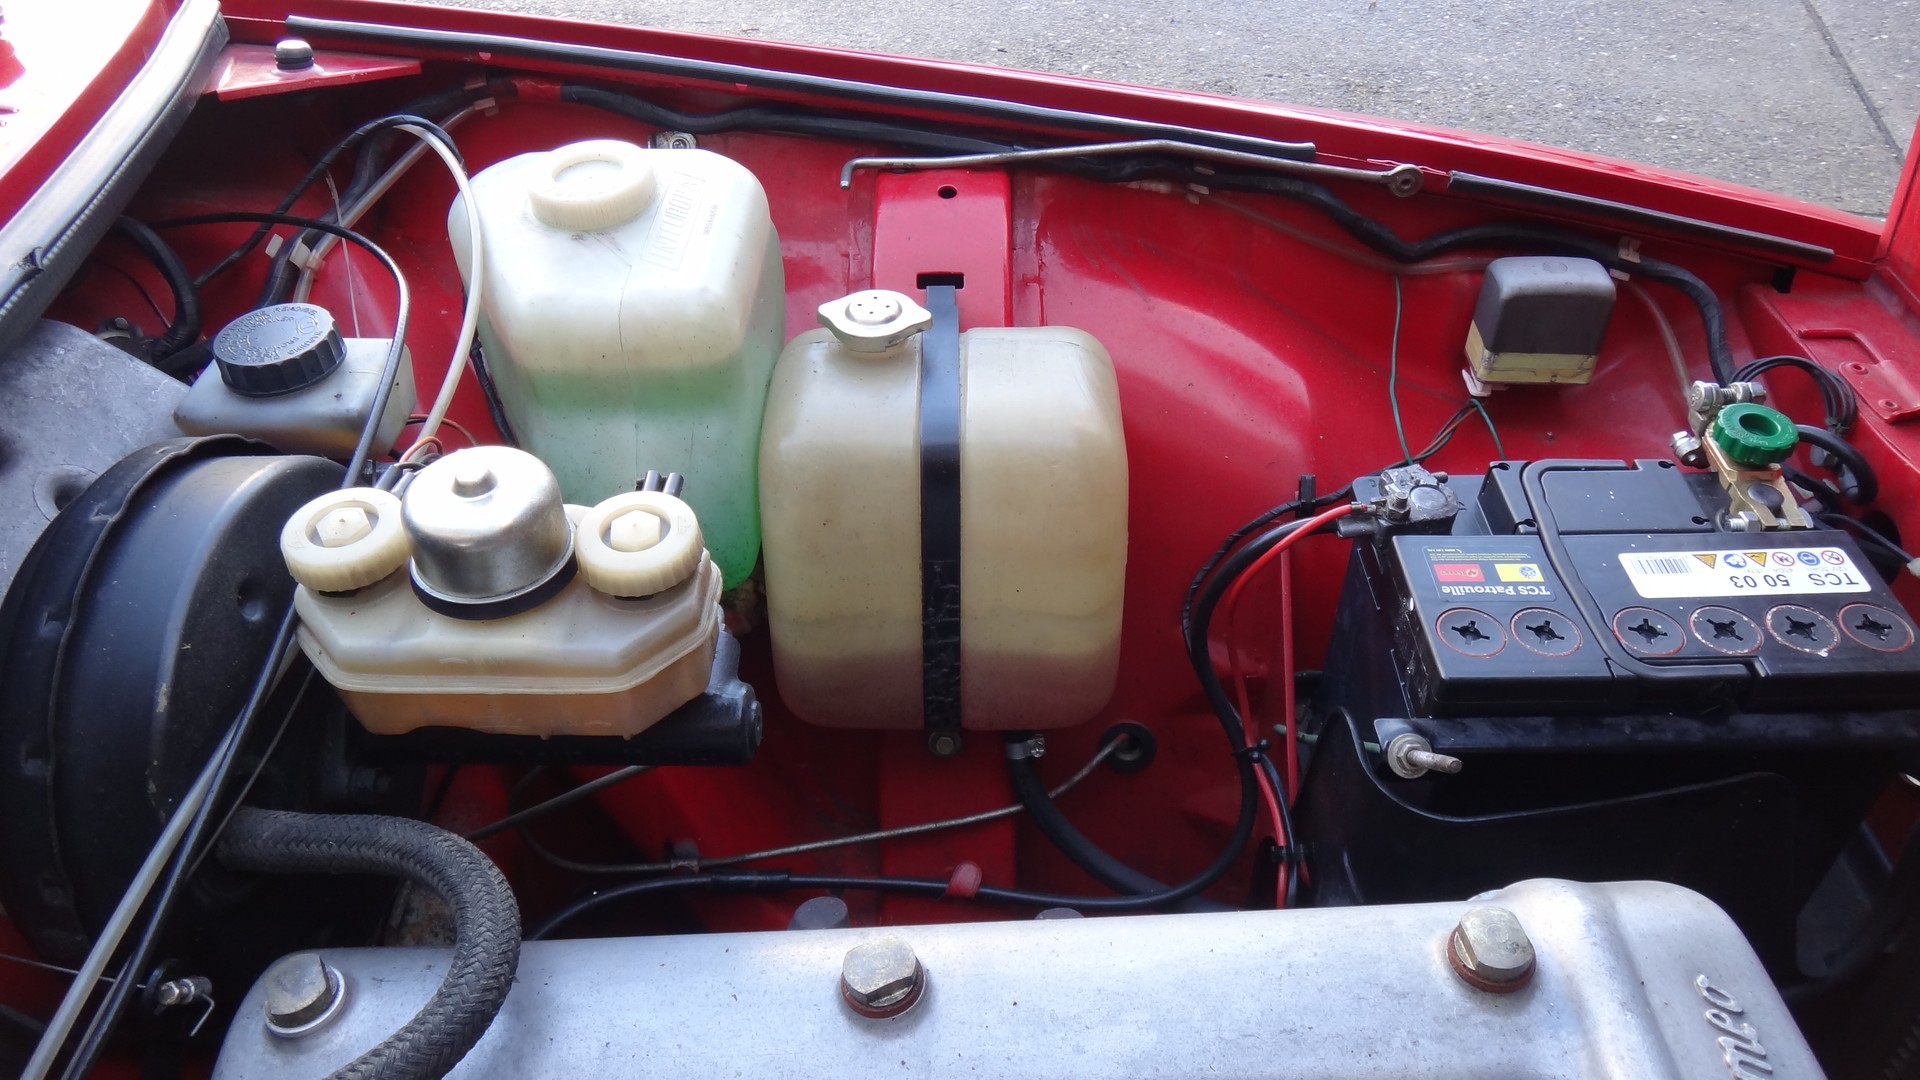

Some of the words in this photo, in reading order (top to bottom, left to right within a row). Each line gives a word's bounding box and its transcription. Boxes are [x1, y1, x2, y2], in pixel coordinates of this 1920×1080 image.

[1730, 575, 1757, 589] 03
[1763, 573, 1791, 588] 50
[1808, 573, 1859, 586] TCS
[1441, 585, 1517, 596] Patrouille
[1518, 585, 1551, 595] TCS
